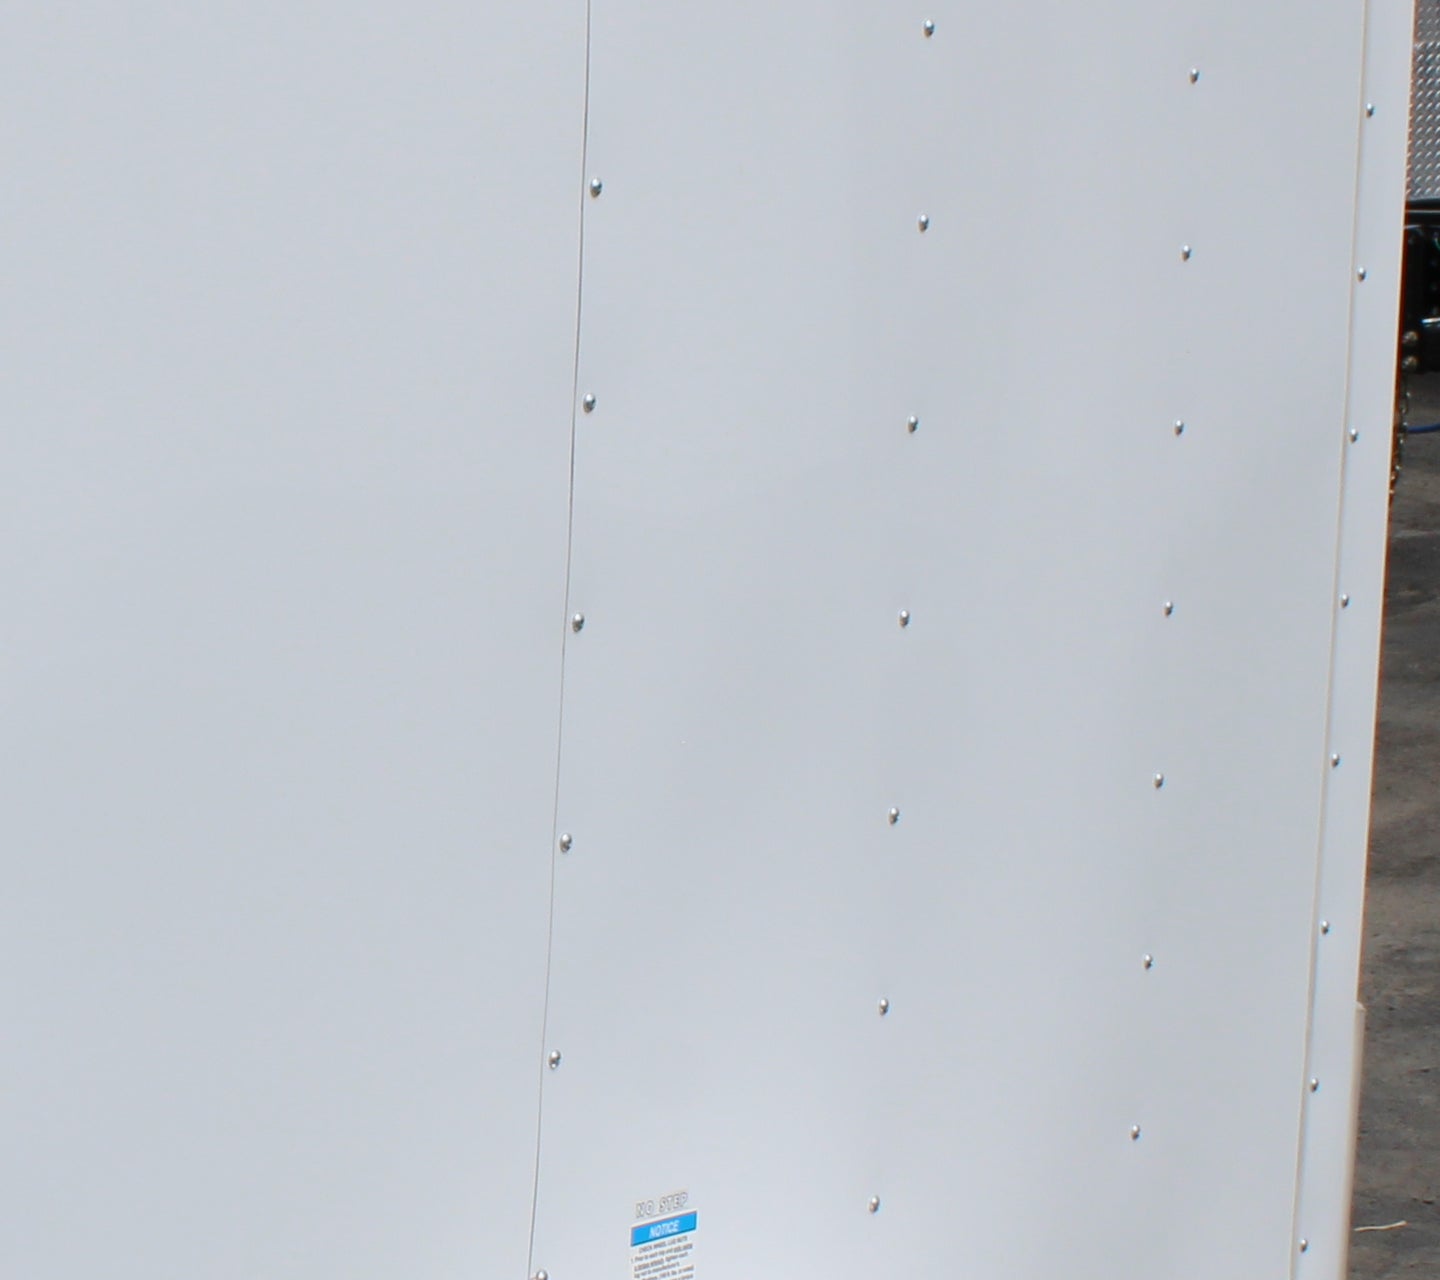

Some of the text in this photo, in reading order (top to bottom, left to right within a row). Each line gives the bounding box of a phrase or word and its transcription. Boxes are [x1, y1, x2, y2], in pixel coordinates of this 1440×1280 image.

[635, 1192, 688, 1218] NO STEP
[649, 1219, 680, 1238] NOTICE
